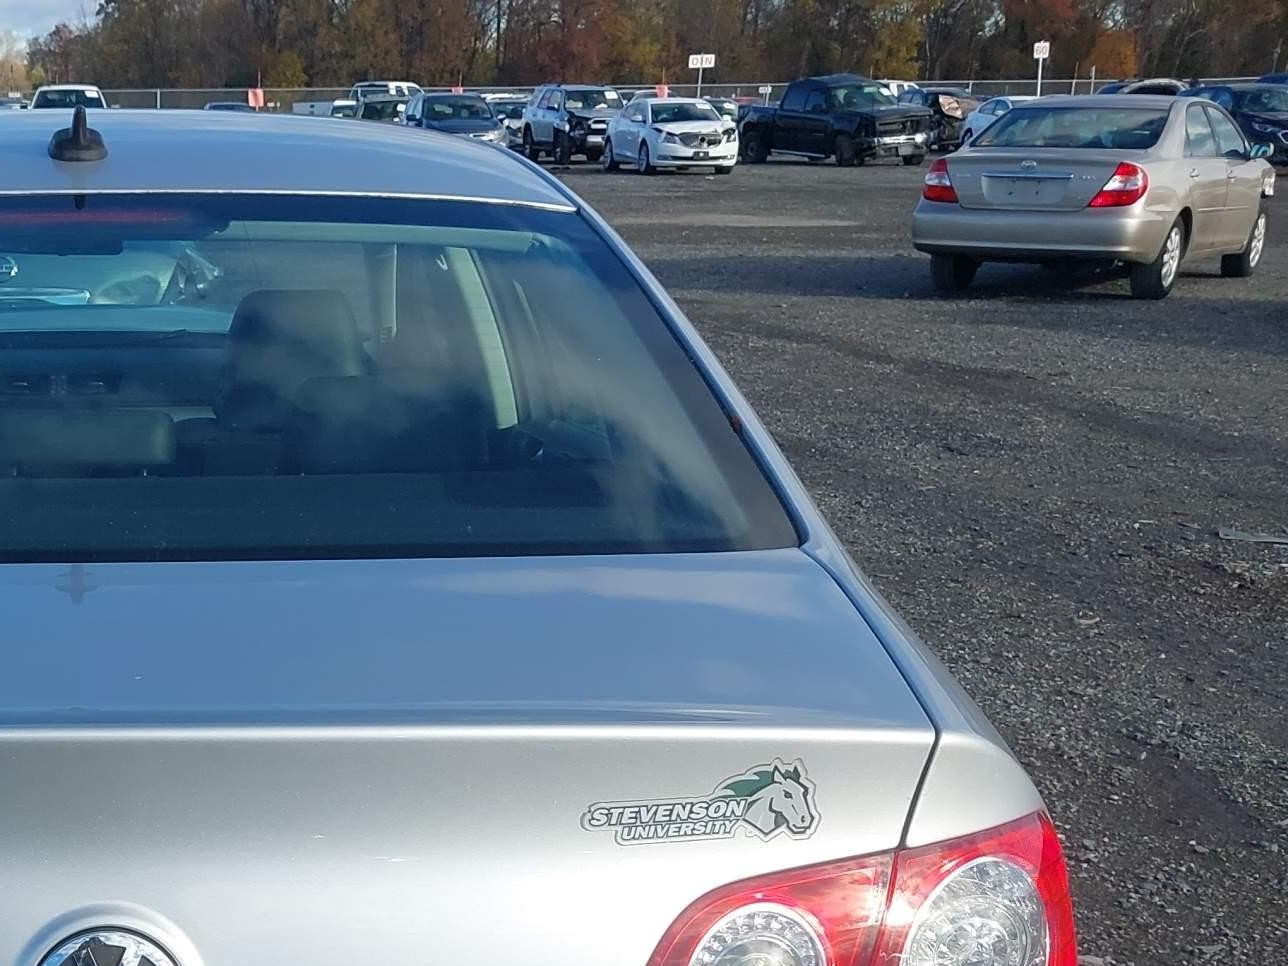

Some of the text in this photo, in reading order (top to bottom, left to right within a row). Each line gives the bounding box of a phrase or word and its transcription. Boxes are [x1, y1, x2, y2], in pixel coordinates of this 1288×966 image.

[1035, 45, 1048, 55] 60
[590, 800, 748, 826] STEVENSON
[621, 819, 740, 842] UNIVERSITY
